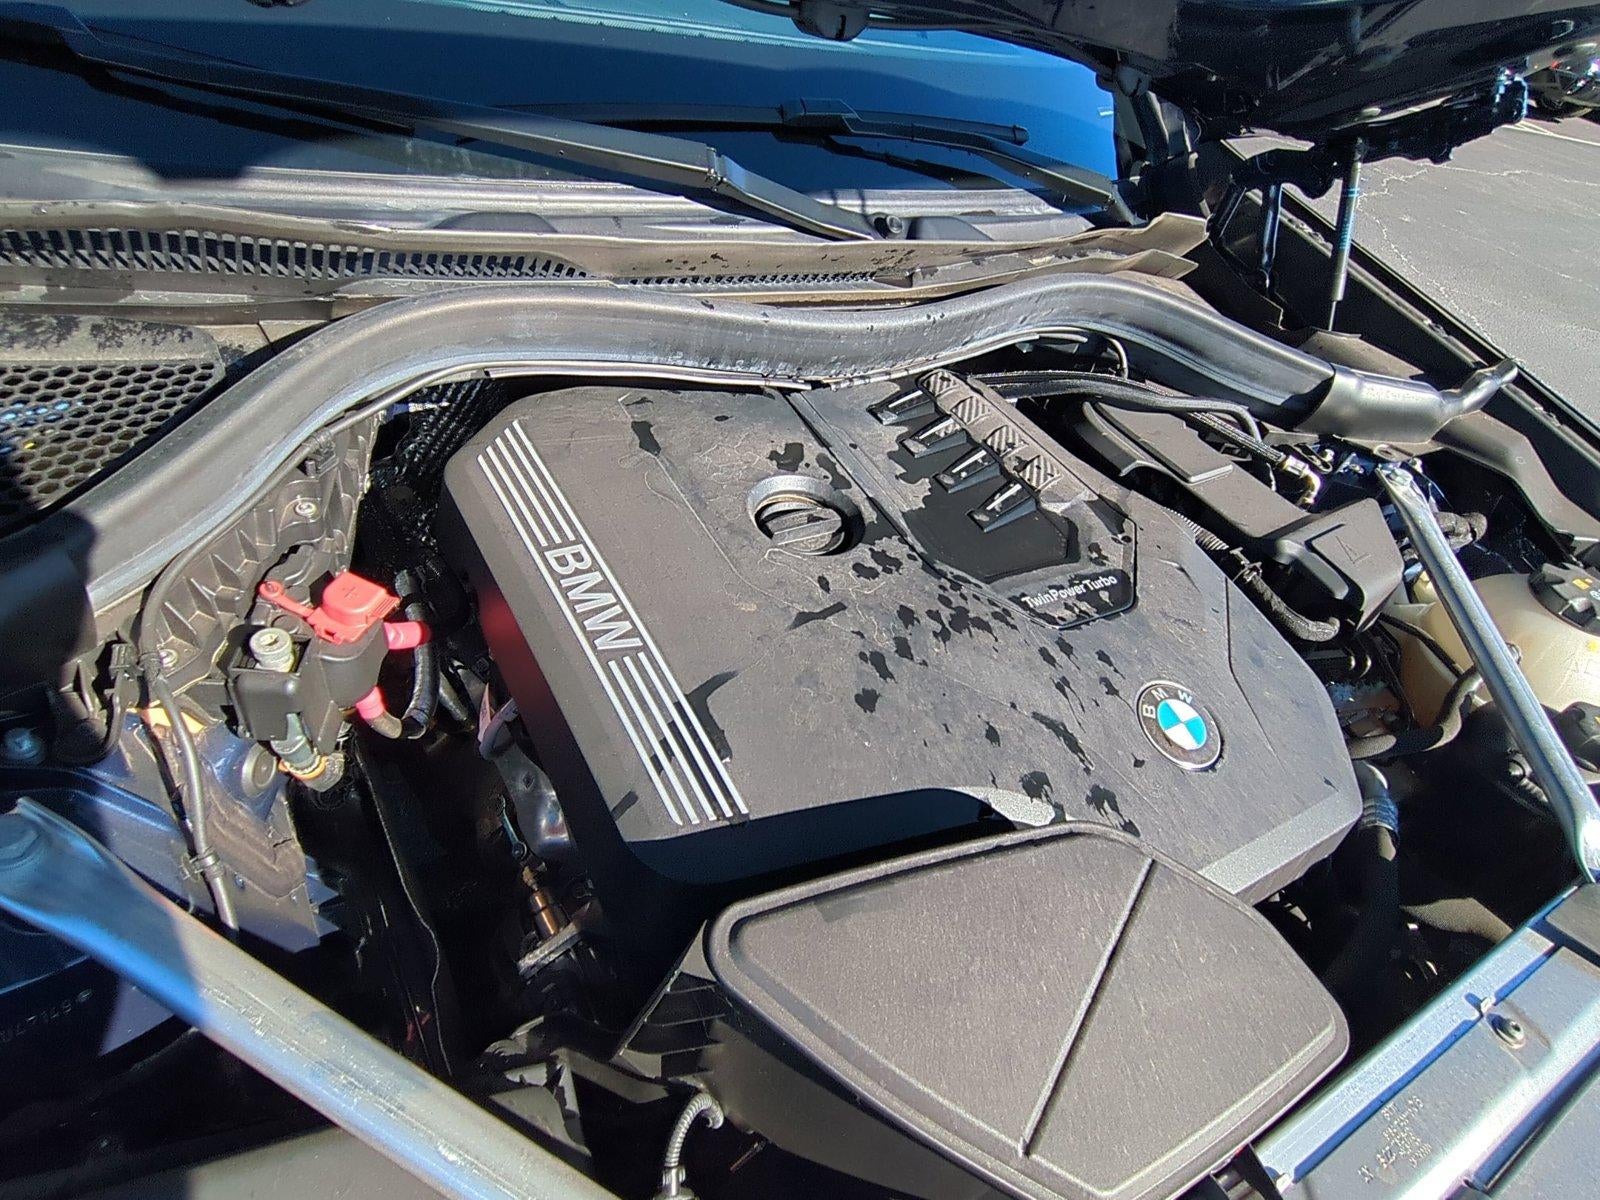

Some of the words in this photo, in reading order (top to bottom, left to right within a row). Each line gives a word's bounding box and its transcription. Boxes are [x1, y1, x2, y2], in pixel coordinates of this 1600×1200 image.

[544, 543, 643, 650] BMW
[1020, 583, 1085, 609] TwinPower
[1082, 574, 1118, 591] Turbo
[1142, 687, 1193, 719] BMW
